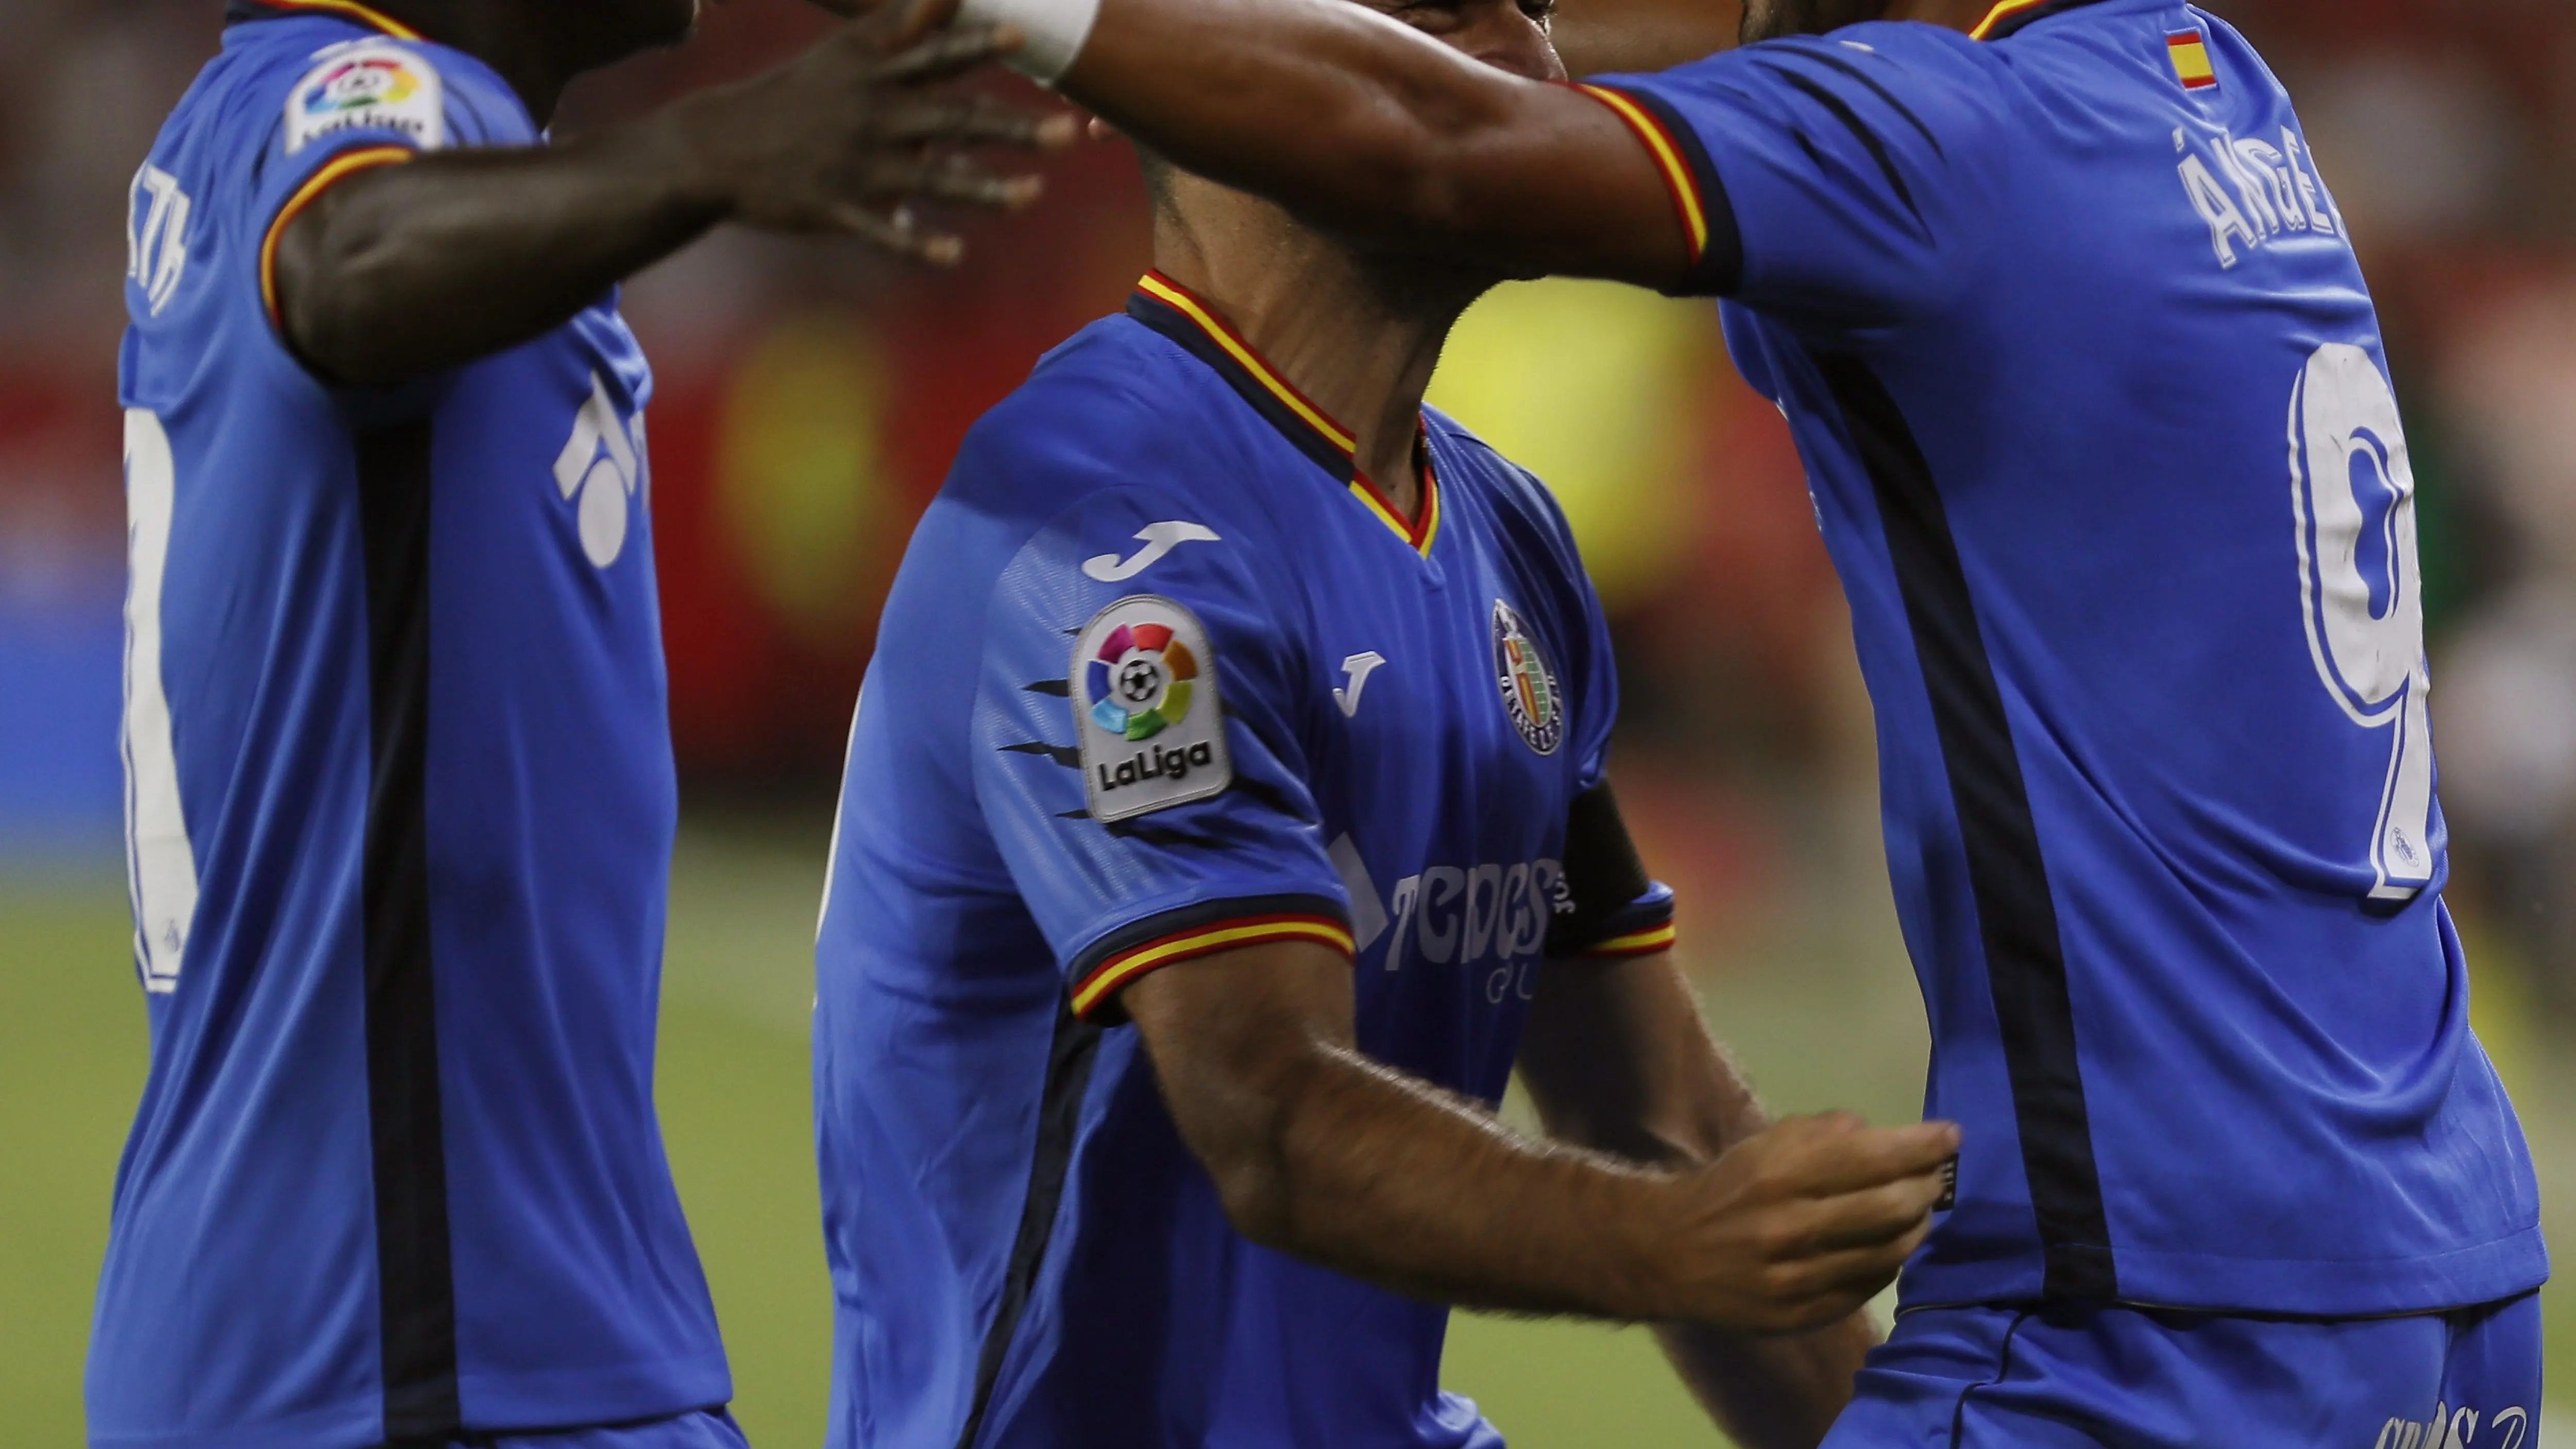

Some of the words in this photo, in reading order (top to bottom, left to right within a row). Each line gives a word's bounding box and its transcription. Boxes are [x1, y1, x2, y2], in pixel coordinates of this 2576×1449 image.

[2171, 125, 2347, 270] ÁNGE
[2287, 342, 2431, 898] 9
[1098, 740, 1212, 791] LaLiga
